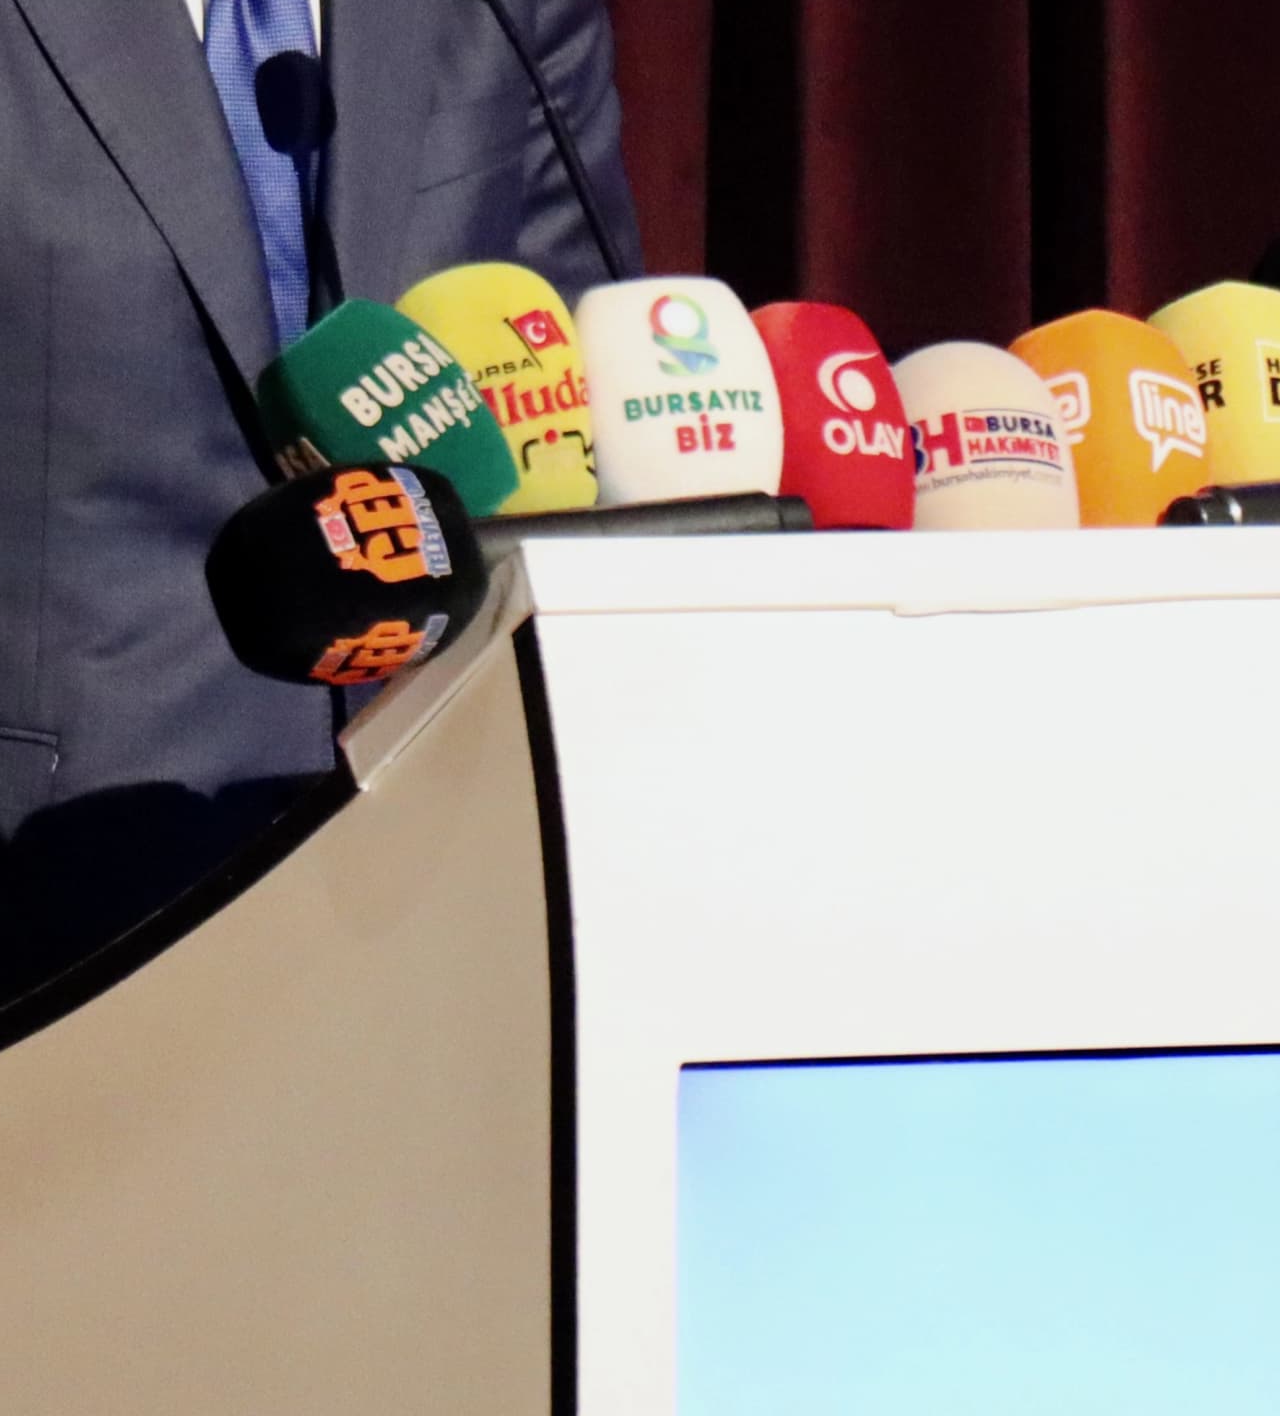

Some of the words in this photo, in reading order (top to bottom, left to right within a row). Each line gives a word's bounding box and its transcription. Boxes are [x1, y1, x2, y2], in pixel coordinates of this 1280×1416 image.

[338, 332, 455, 428] BURSA
[472, 358, 536, 383] URSA
[623, 390, 764, 422] BURSAYIZ
[1140, 381, 1206, 444] line
[676, 414, 736, 454] BİZ
[823, 418, 905, 460] OLAY
[986, 415, 1057, 441] BURSA
